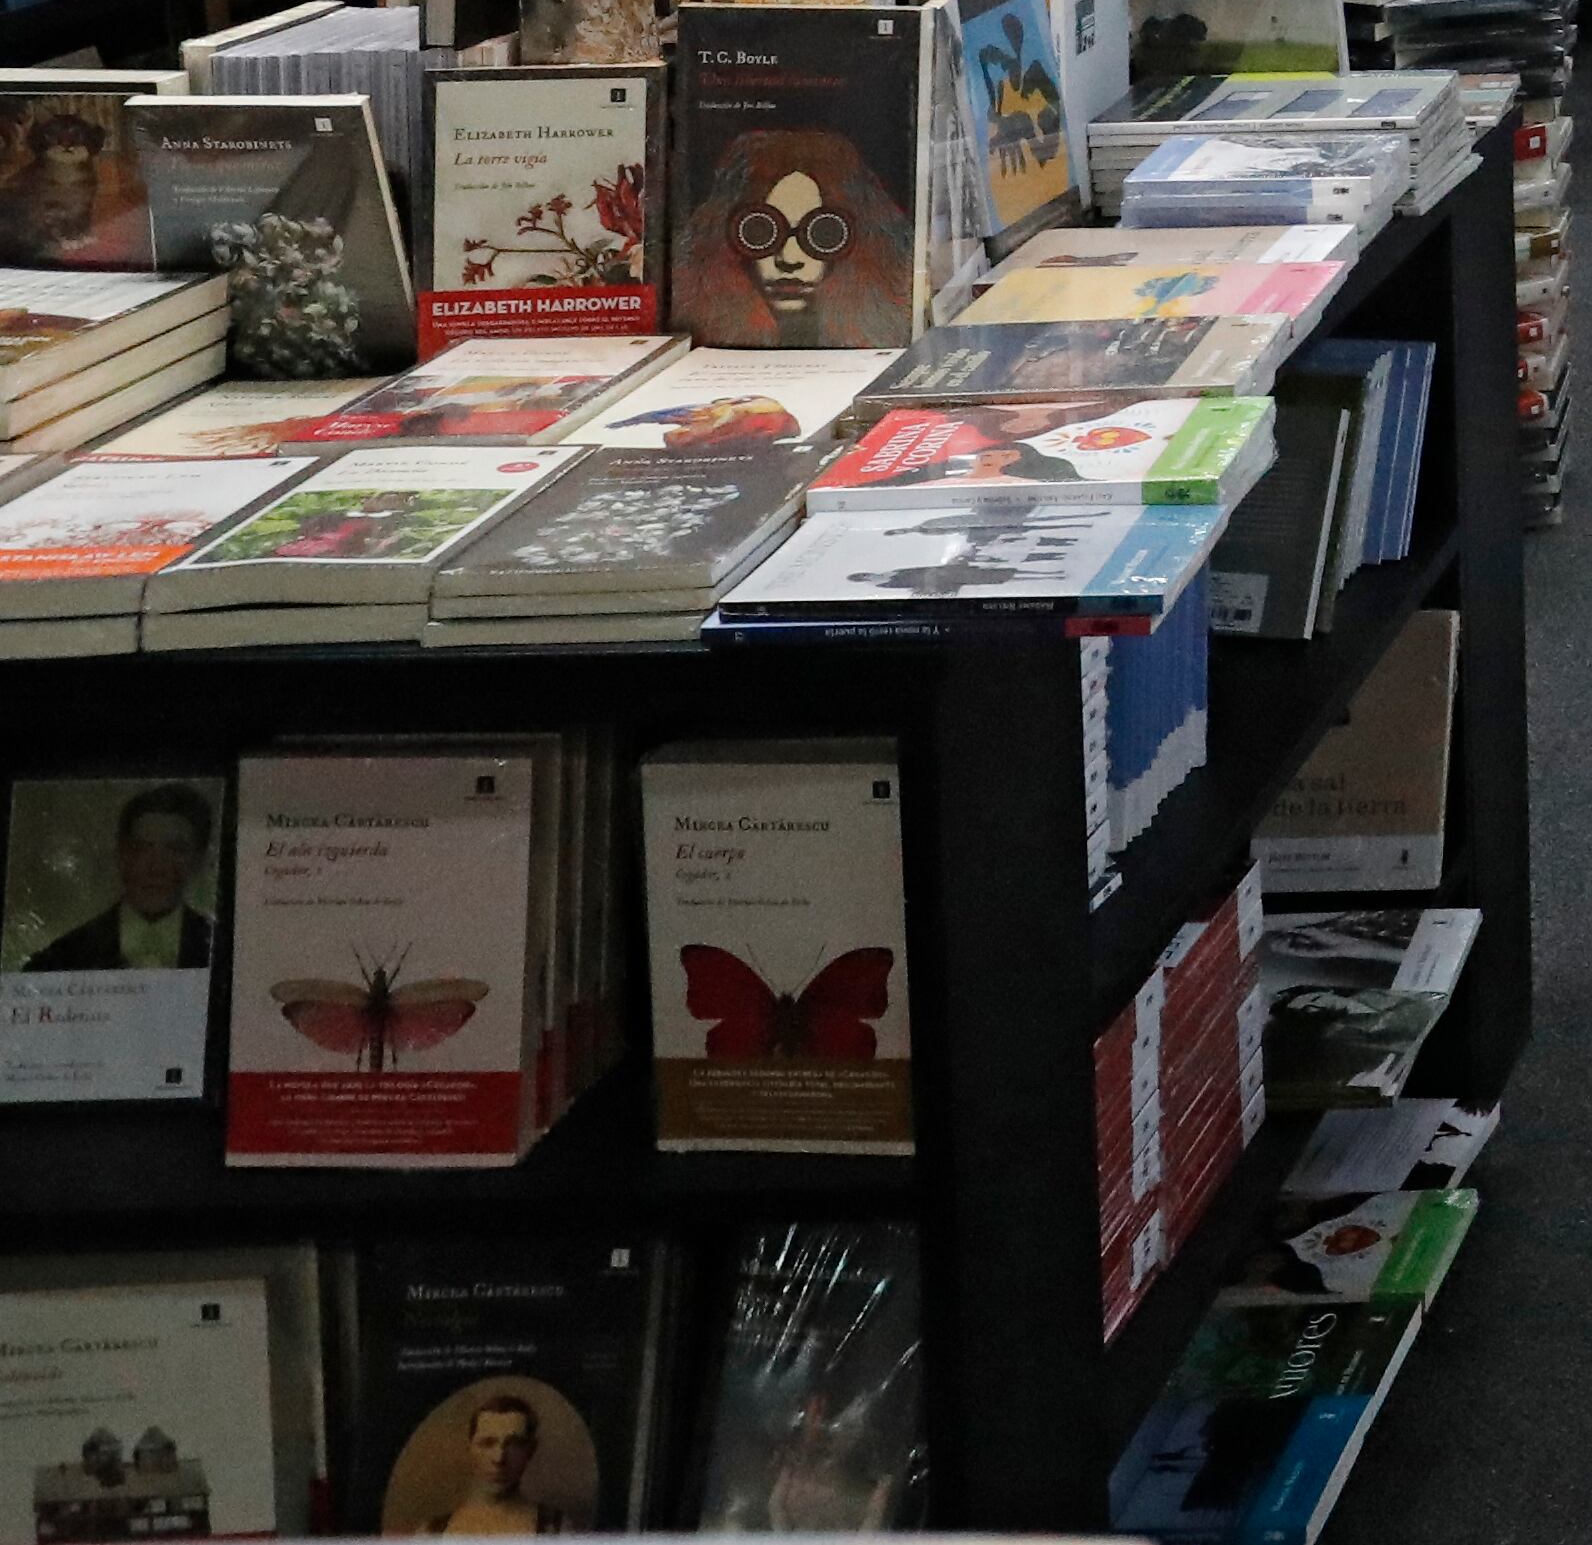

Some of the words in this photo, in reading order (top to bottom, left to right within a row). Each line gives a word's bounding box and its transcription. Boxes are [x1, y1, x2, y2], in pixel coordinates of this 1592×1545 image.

[454, 127, 531, 141] ELIZABETH
[537, 125, 613, 139] HARROWER
[162, 137, 197, 150] ANNA
[202, 137, 292, 151] STAROBINETS
[454, 153, 472, 166] La
[477, 155, 510, 167] torre
[514, 152, 548, 168] vigía
[432, 298, 532, 316] ELIZABETH
[537, 296, 641, 313] HARROWER
[859, 421, 928, 474] SABRINA
[908, 421, 963, 467] CORINA
[677, 845, 696, 859] El
